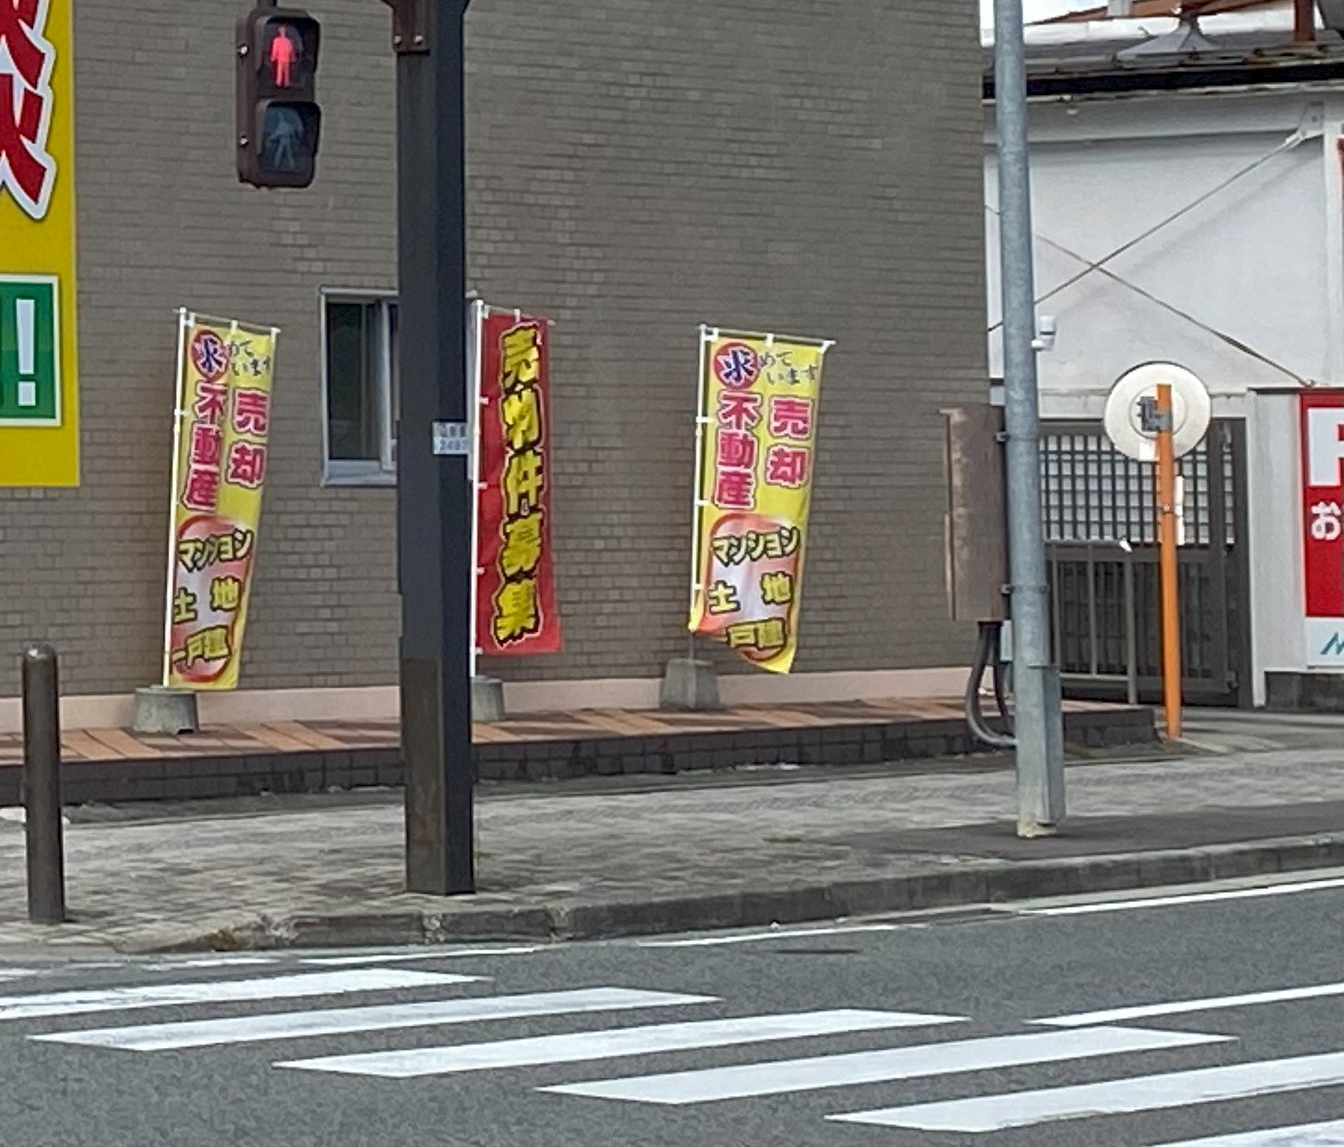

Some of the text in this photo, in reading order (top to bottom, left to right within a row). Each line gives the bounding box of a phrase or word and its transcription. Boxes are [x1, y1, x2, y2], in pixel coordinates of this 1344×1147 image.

[184, 381, 228, 511] 不動産
[228, 388, 271, 490] 売却
[714, 390, 763, 510] 不動産
[765, 395, 814, 489] 売却
[708, 571, 794, 615] 土地
[711, 526, 801, 567] マンション
[172, 575, 242, 625] 土地
